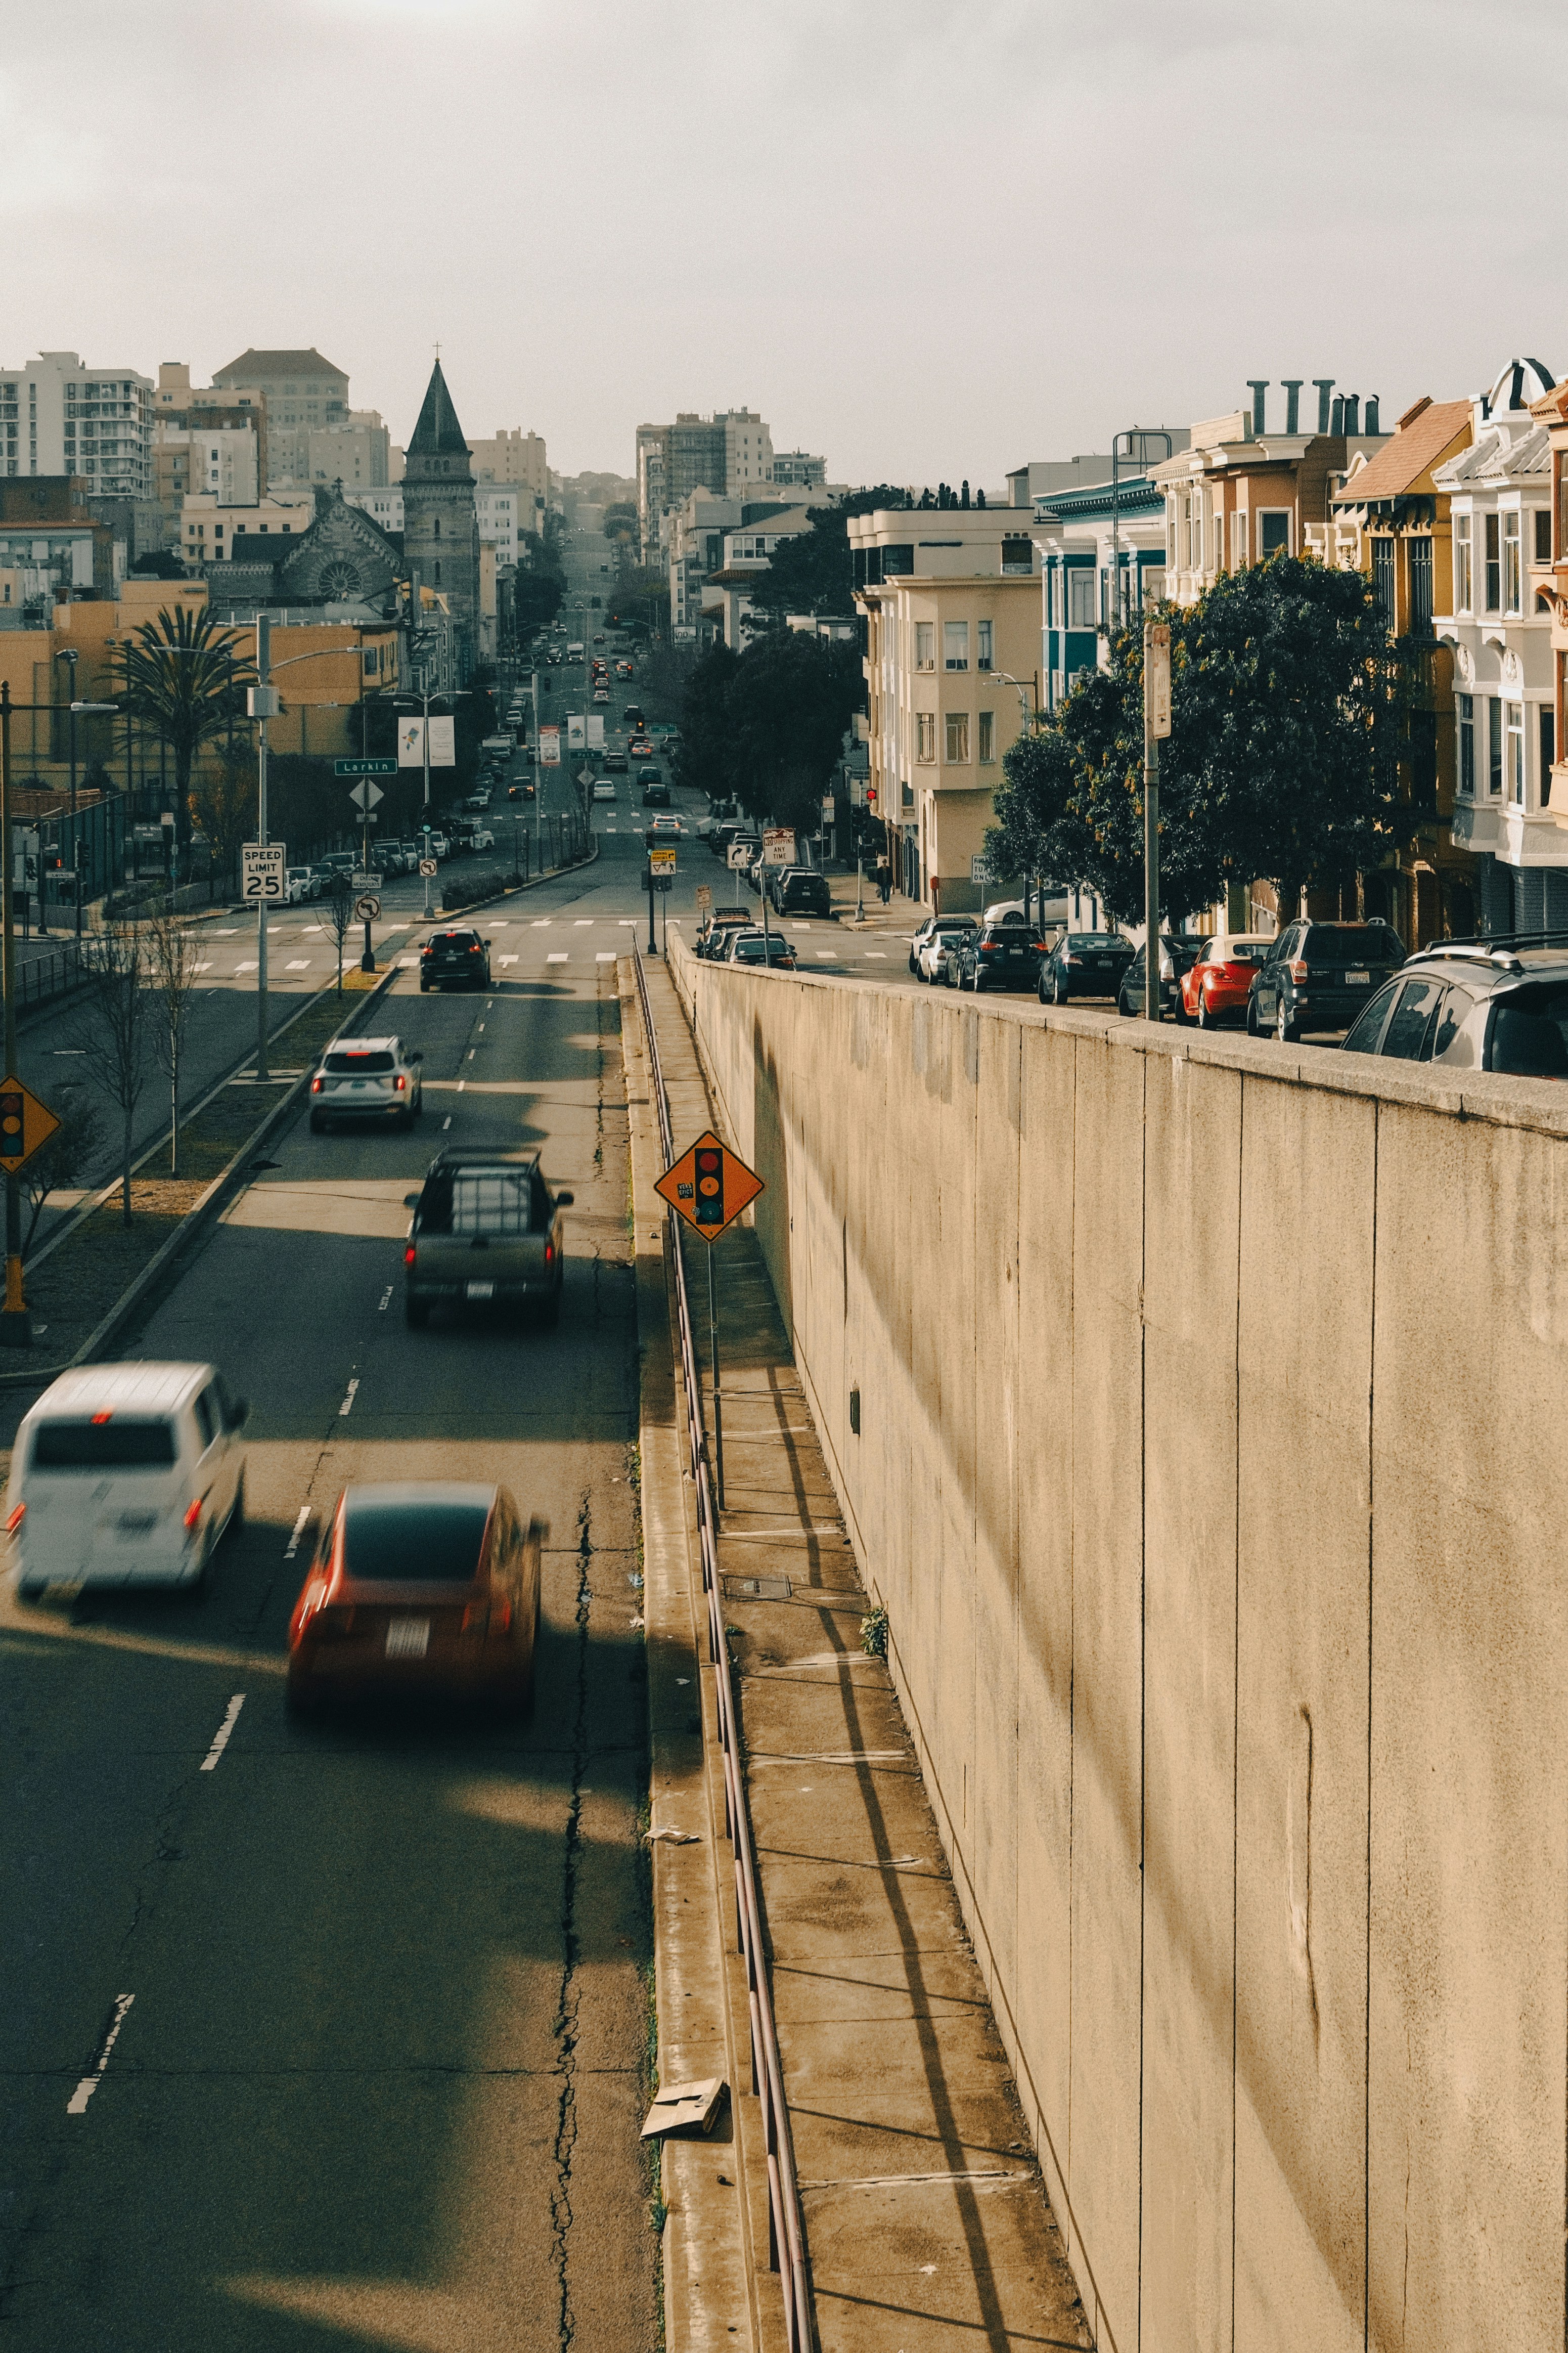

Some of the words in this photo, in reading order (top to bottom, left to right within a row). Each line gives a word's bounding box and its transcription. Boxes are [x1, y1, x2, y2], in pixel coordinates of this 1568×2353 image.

[344, 762, 388, 771] Larkin
[245, 851, 281, 860] SPEED
[248, 864, 277, 872] LIMIT
[247, 876, 280, 895] 25
